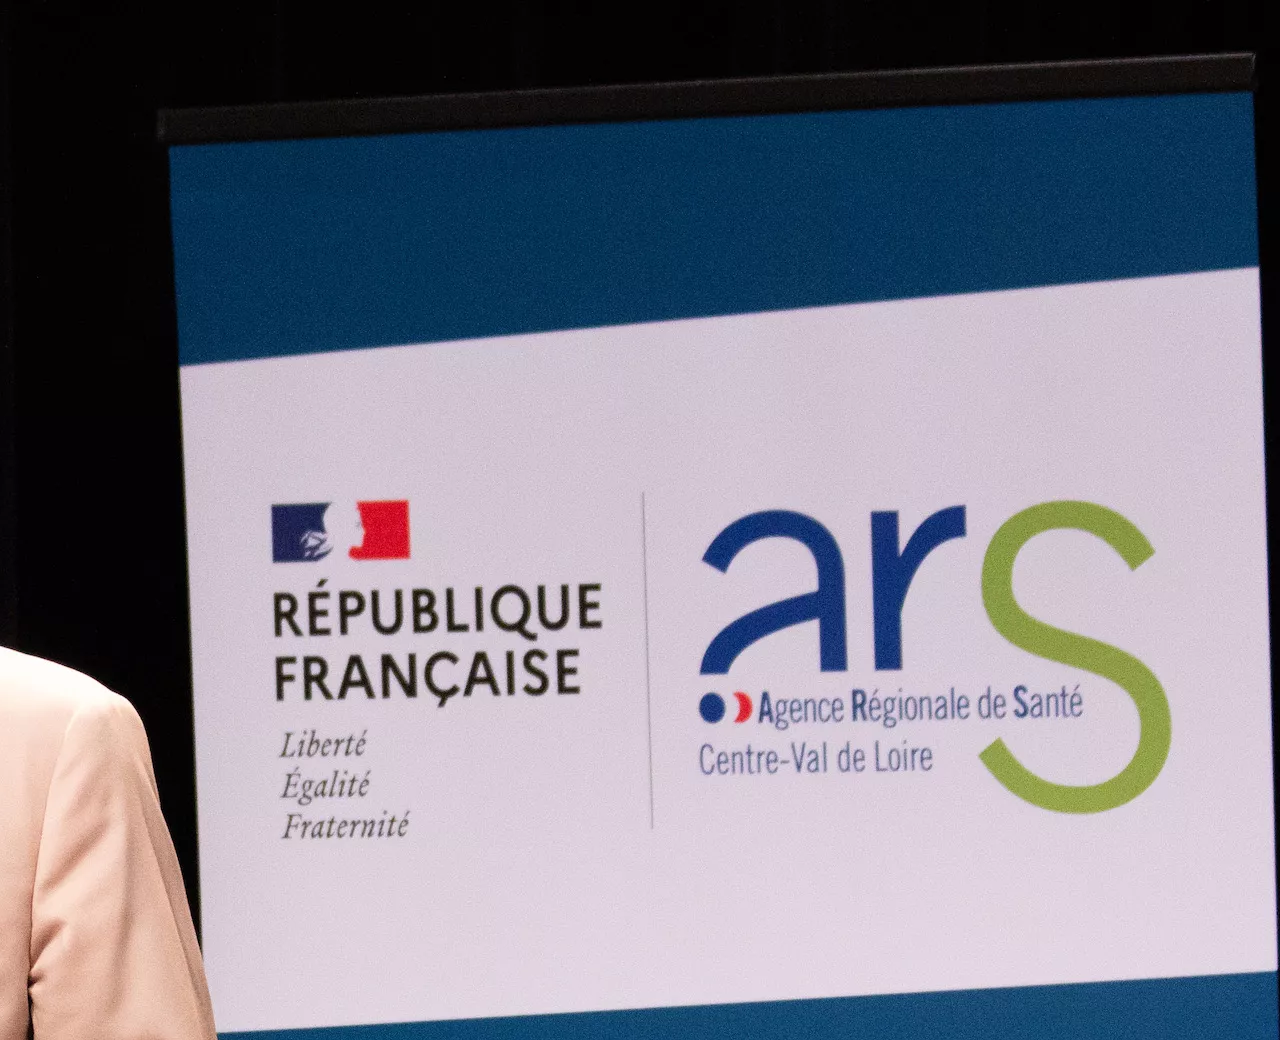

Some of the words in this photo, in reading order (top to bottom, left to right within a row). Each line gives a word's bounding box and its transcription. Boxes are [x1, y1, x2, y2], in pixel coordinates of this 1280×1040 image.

[273, 578, 602, 641] RÉPUBLIQUE
[275, 648, 581, 708] FRANÇAISE
[758, 691, 844, 730] Agence
[852, 688, 970, 728] Régionale
[978, 686, 1007, 719] de
[1013, 684, 1084, 718] Santé
[279, 729, 368, 758] Liberté
[699, 741, 828, 775] Centre-Val
[838, 741, 866, 773] de
[875, 739, 934, 773] Loire
[280, 766, 371, 805] Égalité
[282, 810, 411, 839] Fraternité
